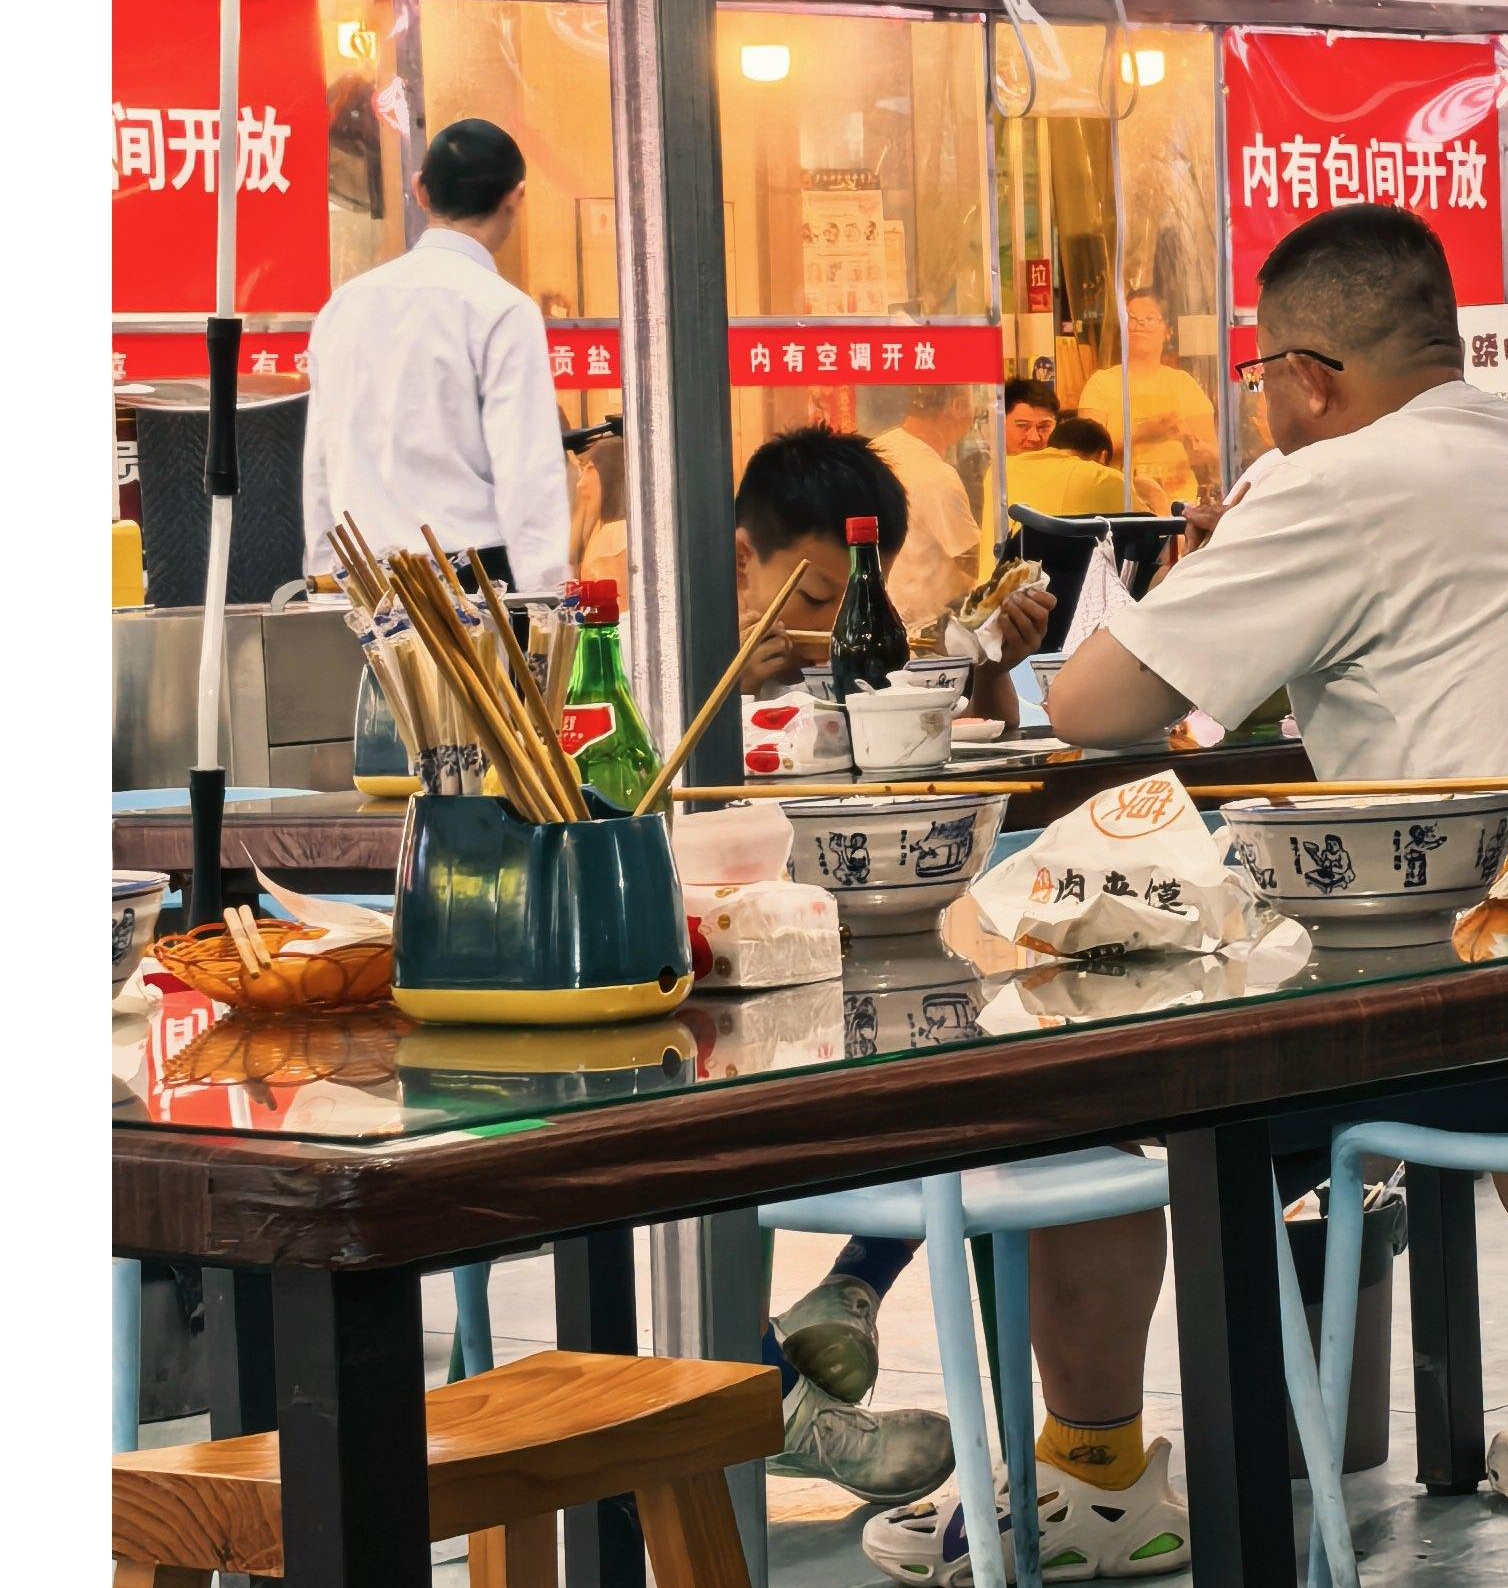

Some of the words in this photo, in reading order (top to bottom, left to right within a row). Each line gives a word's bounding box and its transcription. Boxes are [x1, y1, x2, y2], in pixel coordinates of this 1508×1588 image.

[1242, 131, 1488, 210] 内有包间开放
[548, 344, 612, 377] 贡盐
[750, 342, 936, 373] 内有空调开放
